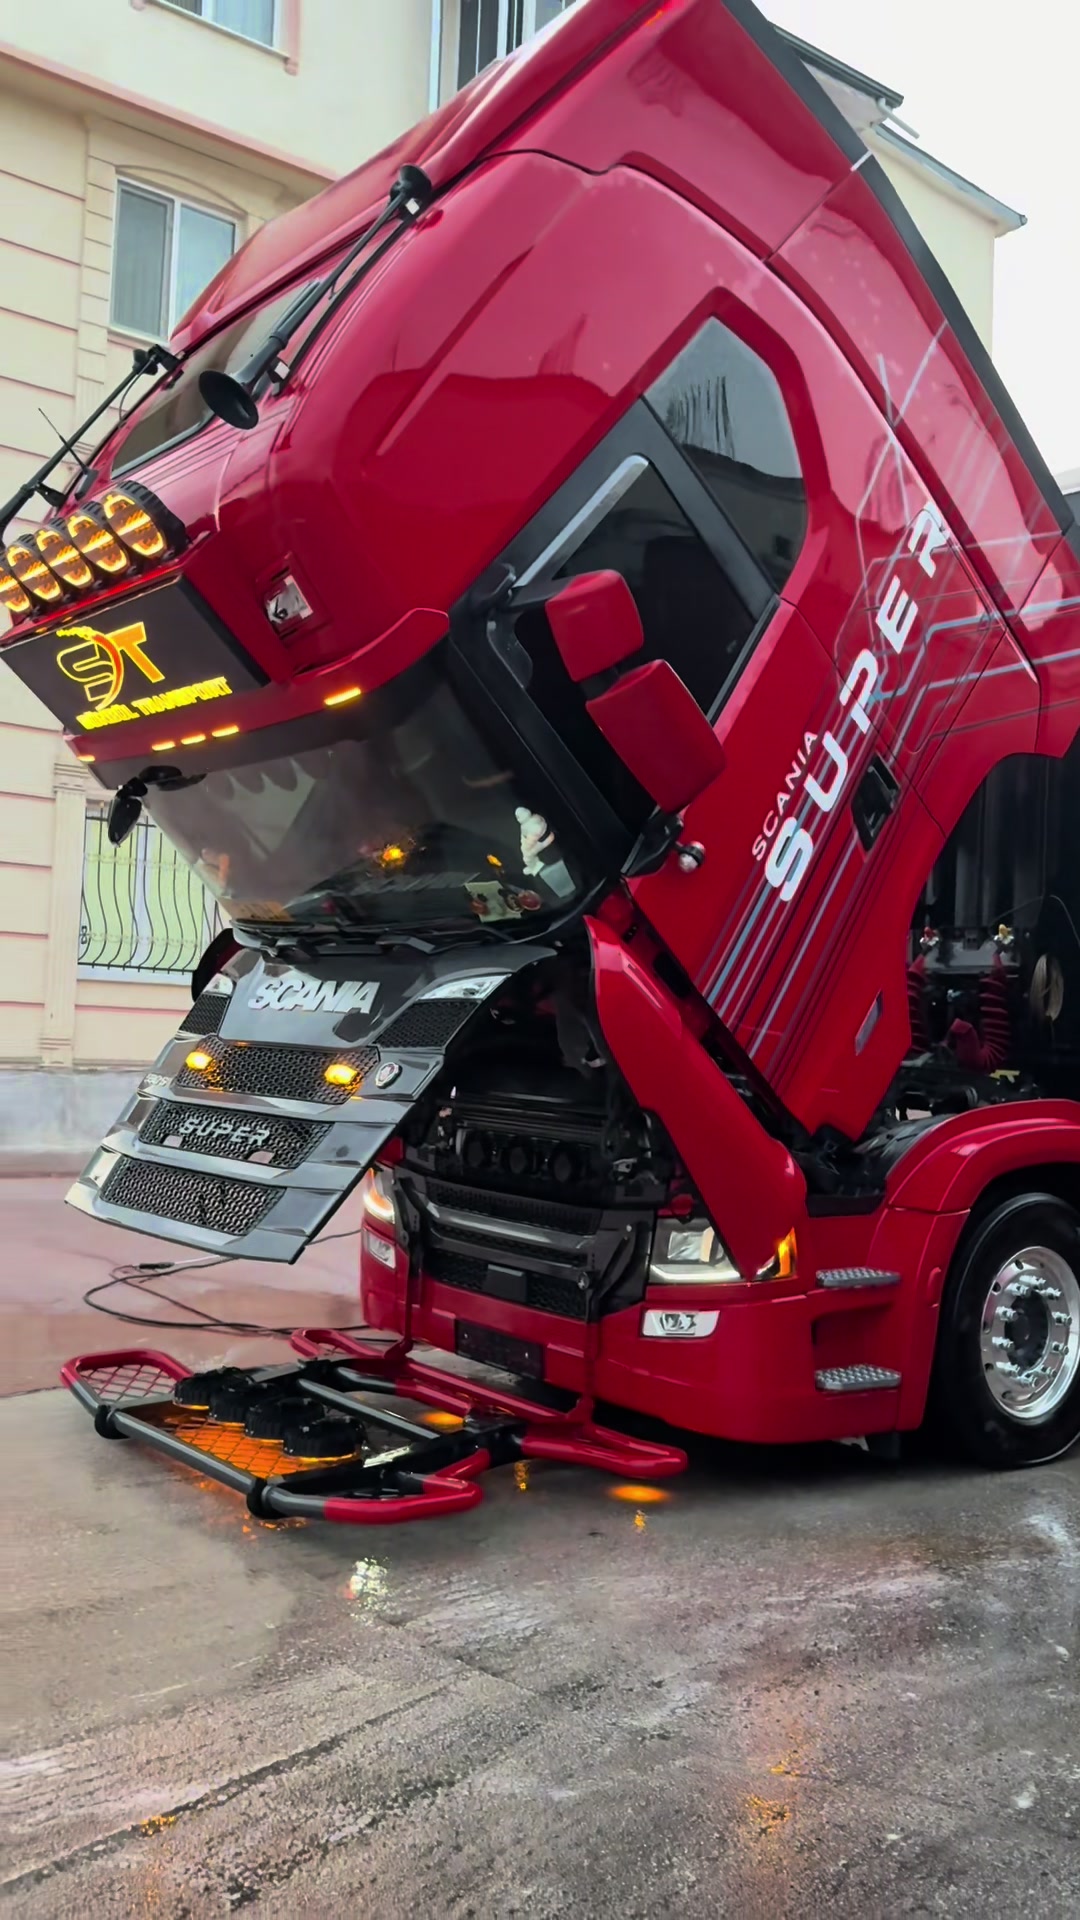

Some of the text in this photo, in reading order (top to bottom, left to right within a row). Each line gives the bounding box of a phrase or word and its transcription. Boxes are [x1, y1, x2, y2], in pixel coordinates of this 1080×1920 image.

[765, 501, 950, 901] SUPER
[752, 731, 818, 861] SCANIA
[247, 979, 381, 1015] SCANIA
[179, 1117, 271, 1146] SUPER
